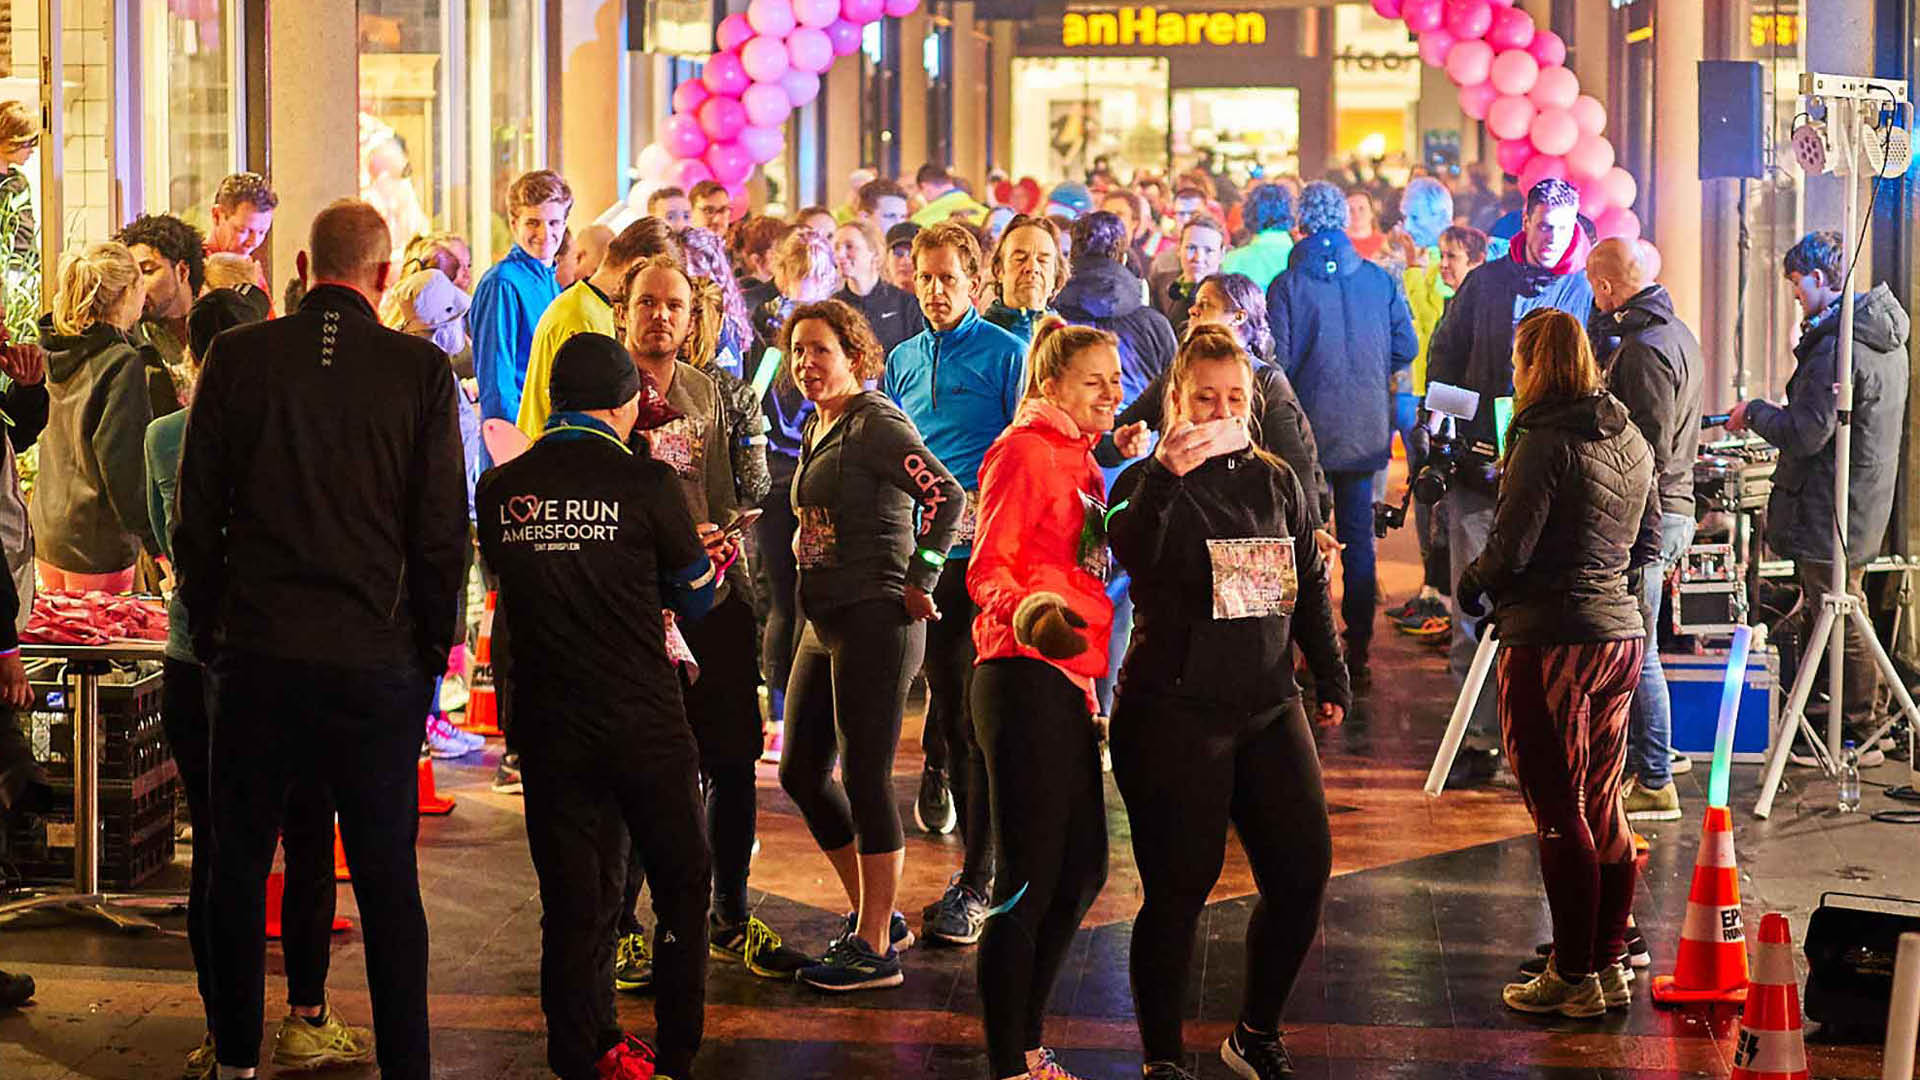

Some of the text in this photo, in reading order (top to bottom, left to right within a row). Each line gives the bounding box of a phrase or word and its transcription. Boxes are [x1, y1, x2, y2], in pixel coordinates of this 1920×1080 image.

[1062, 7, 1267, 46] anHaren
[565, 499, 619, 522] RUN
[502, 523, 618, 543] AMERSFOORT
